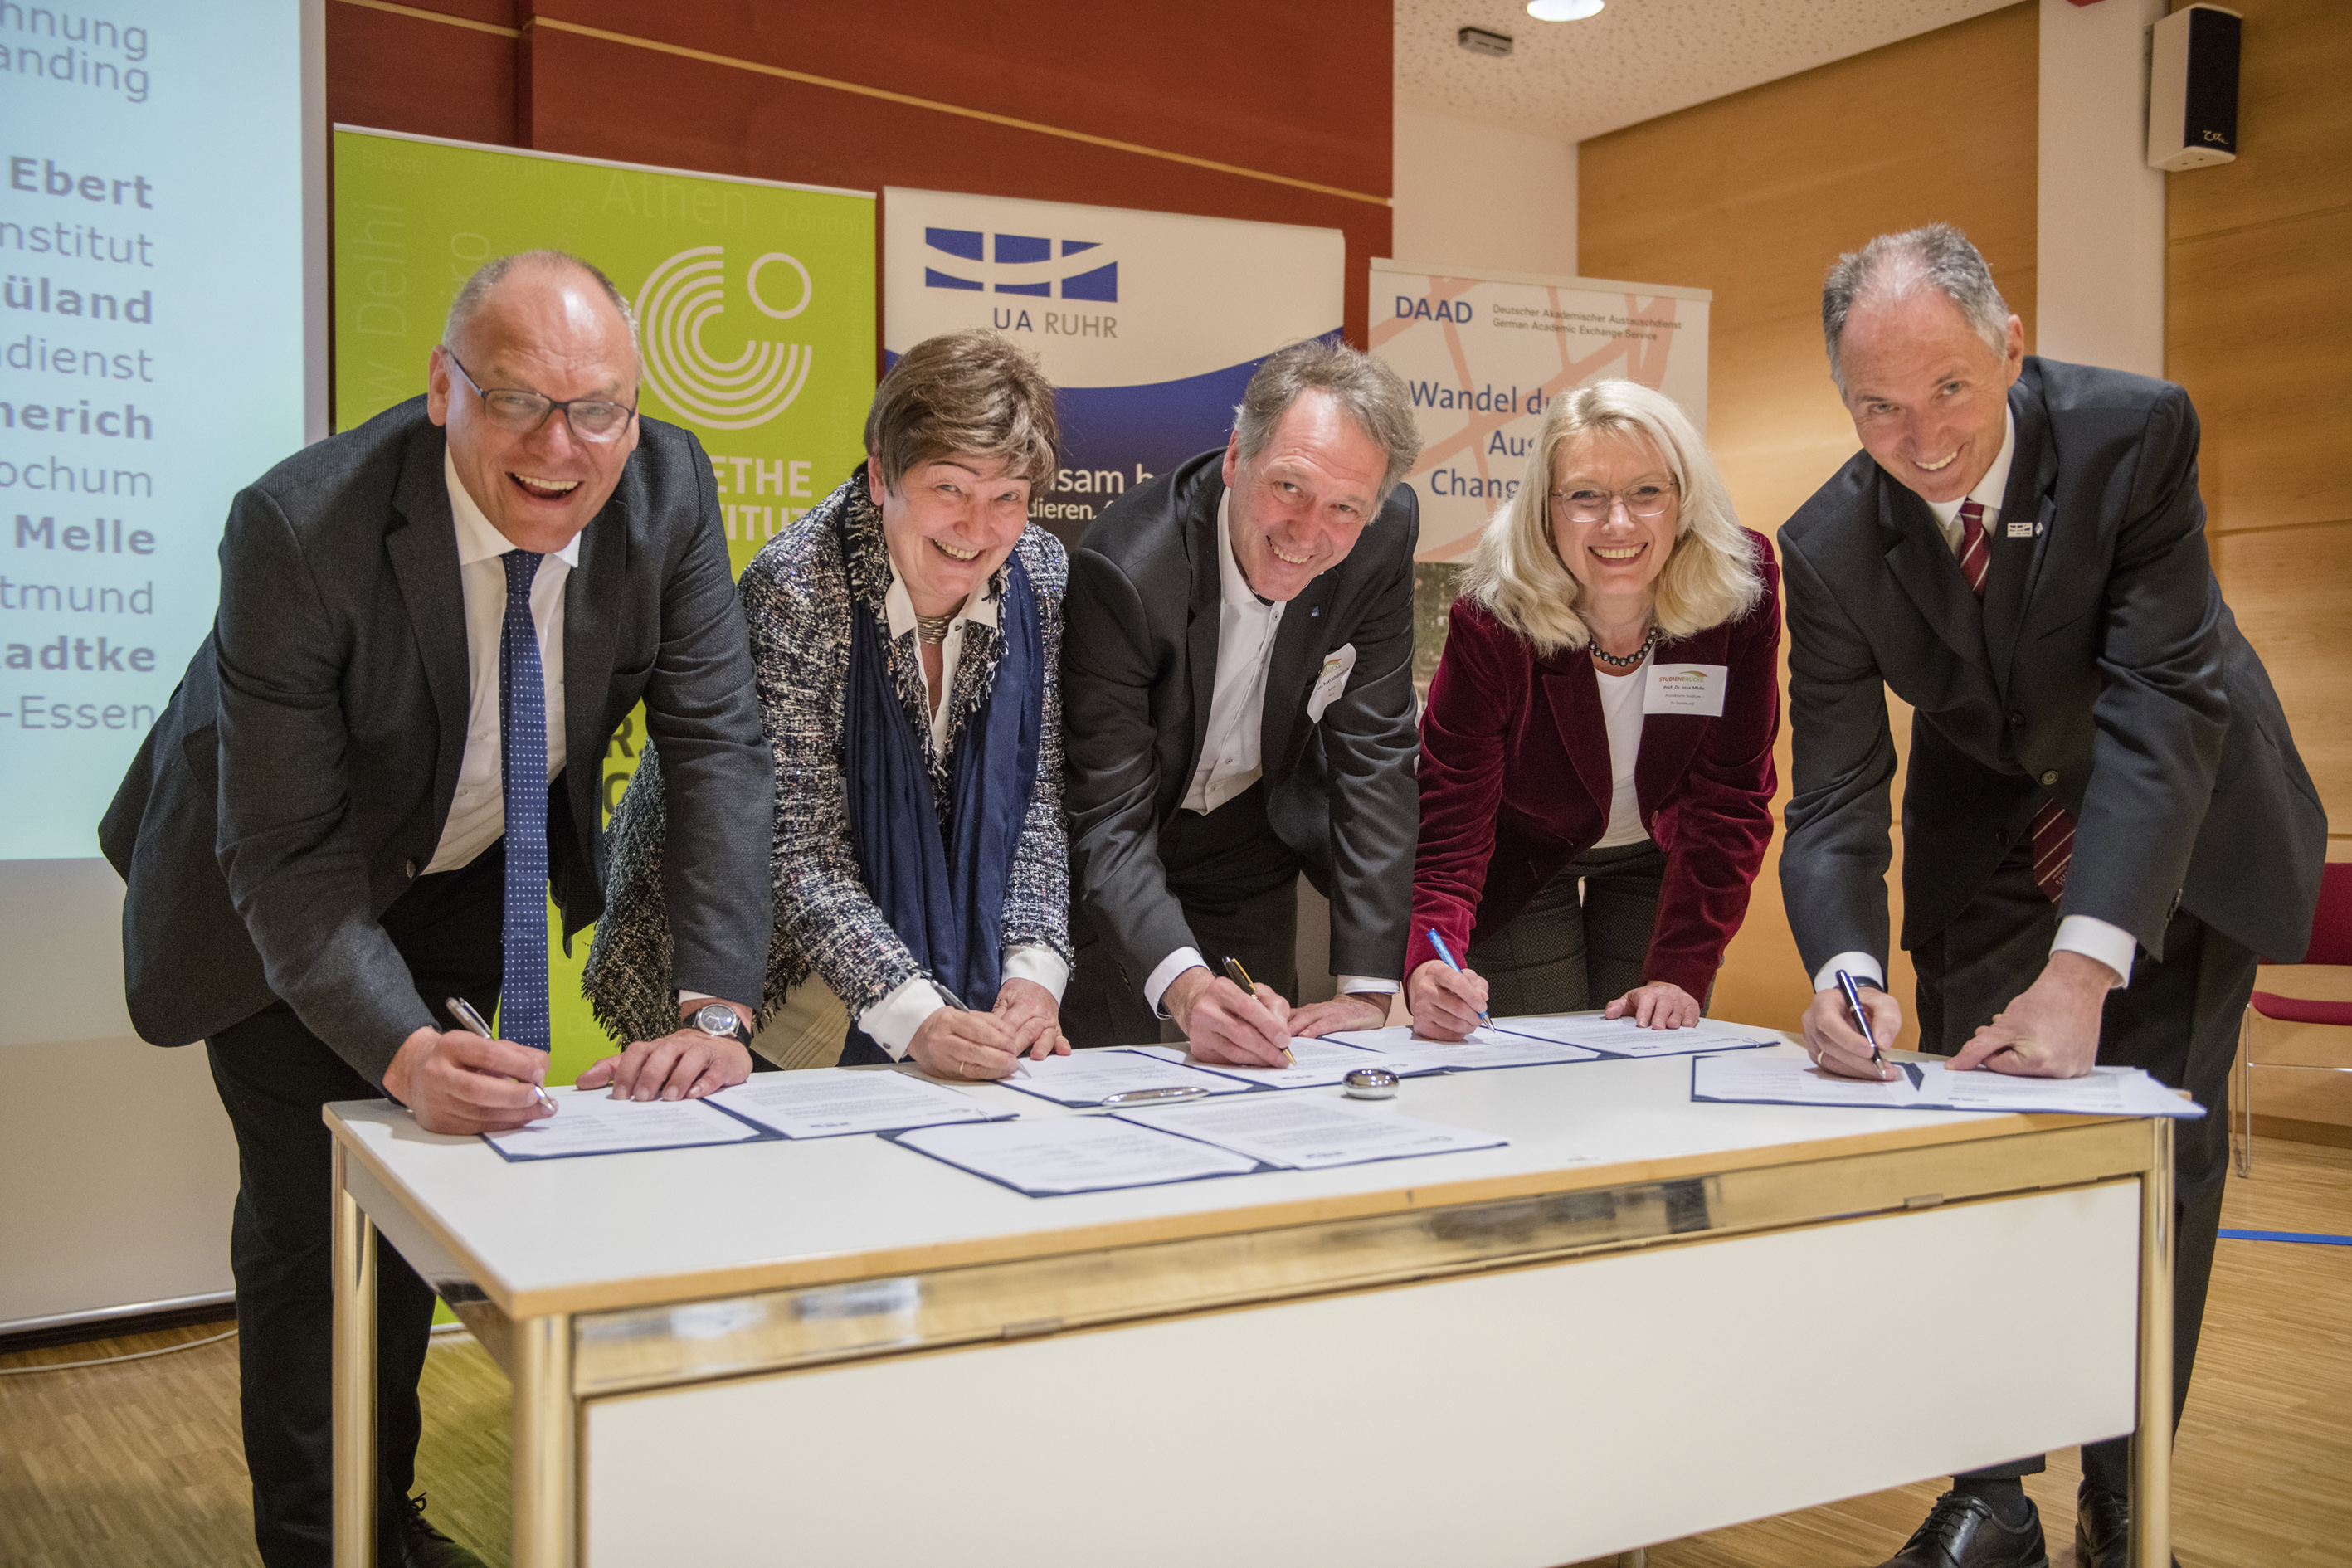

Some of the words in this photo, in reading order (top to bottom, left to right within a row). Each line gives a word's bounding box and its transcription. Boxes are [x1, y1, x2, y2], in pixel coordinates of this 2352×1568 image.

[10, 155, 153, 210] Ebert
[601, 168, 748, 229] Athen
[352, 197, 407, 337] Delhi
[4, 275, 152, 324] üland
[1395, 295, 1473, 324] DAAD
[1493, 304, 1539, 317] Deutscher
[1542, 309, 1606, 324] Akademischer
[1609, 314, 1682, 330] Austauschdienst
[994, 308, 1033, 332] UA
[1045, 312, 1118, 338] RUHR
[1493, 318, 1529, 330] German
[1531, 321, 1576, 334] Academic
[1579, 324, 1623, 338] Exchange
[1625, 329, 1658, 341] Service
[0, 335, 153, 382] dienst
[1409, 380, 1517, 414] Wandel
[1050, 468, 1124, 494] sam
[15, 514, 155, 555] Melle
[0, 576, 153, 615] tmund
[5, 635, 155, 672] adtke
